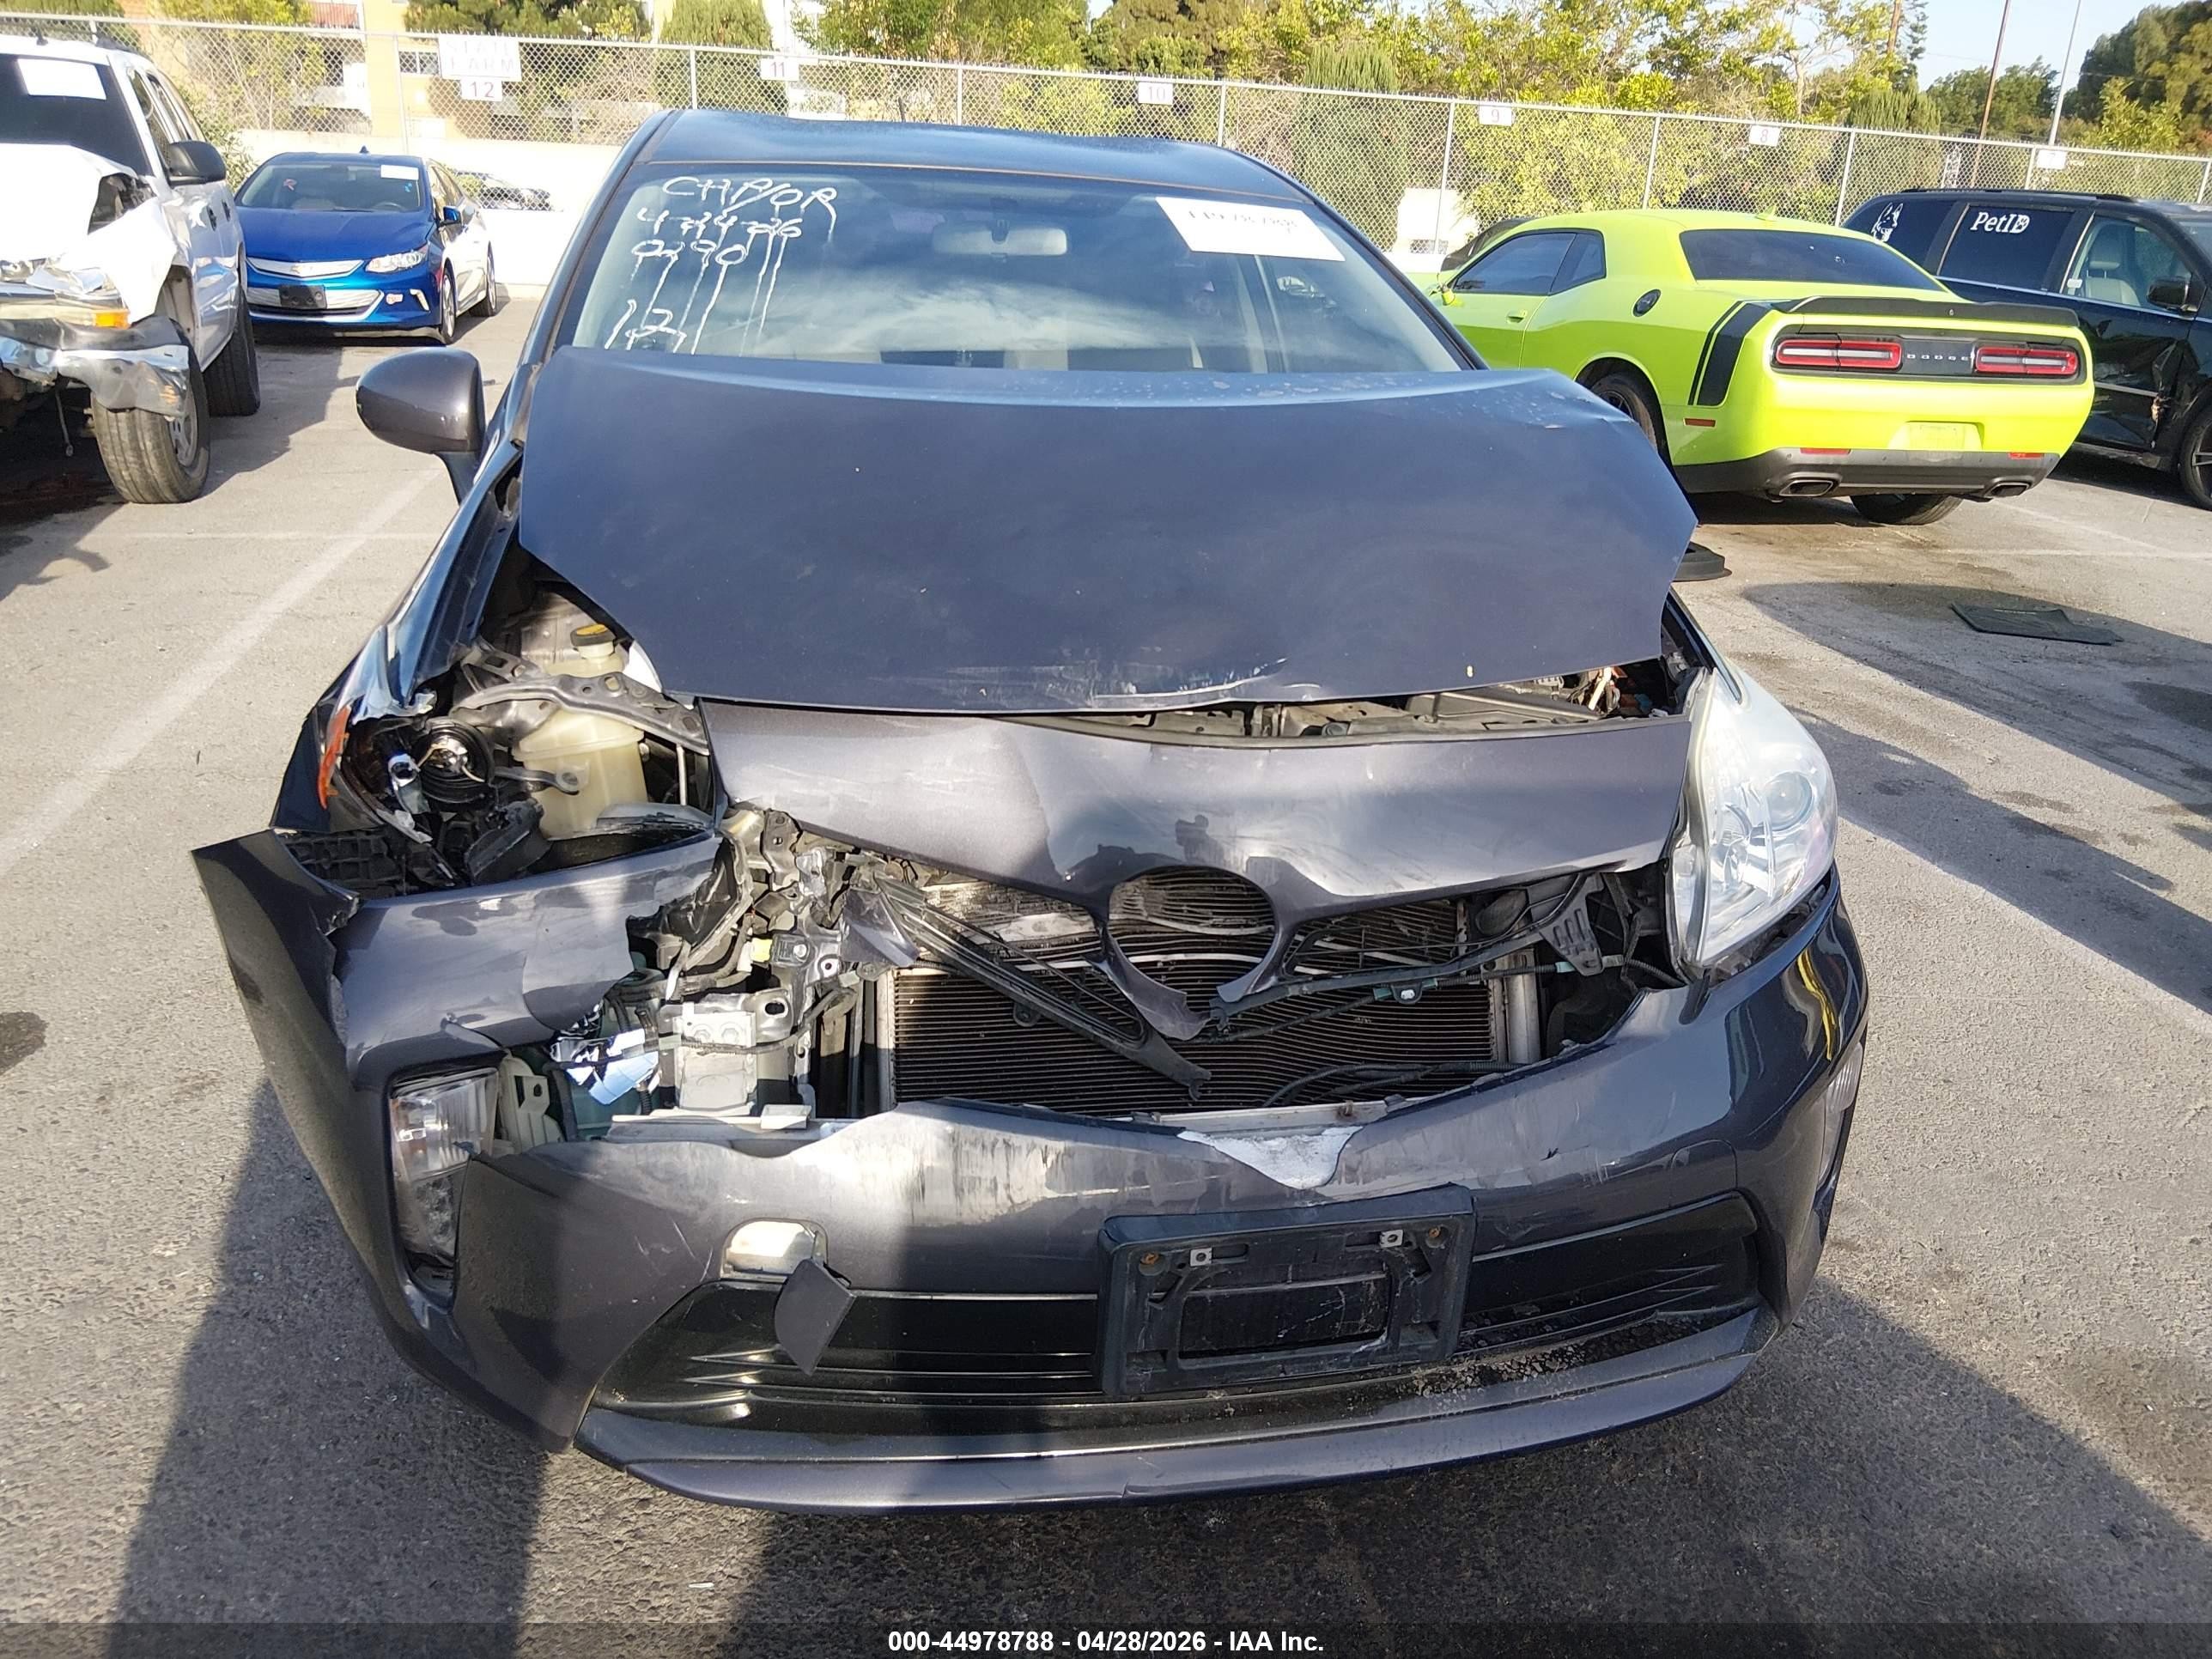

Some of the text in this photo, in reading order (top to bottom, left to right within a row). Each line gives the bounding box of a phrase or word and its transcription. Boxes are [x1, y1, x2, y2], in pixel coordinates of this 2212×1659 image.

[769, 61, 785, 77] 11
[470, 81, 495, 98] 12
[1148, 86, 1166, 101] 10
[1491, 108, 1499, 123] 9
[1760, 129, 1769, 143] 8
[1970, 211, 2030, 234] PetID
[1906, 353, 1969, 362] DODGE
